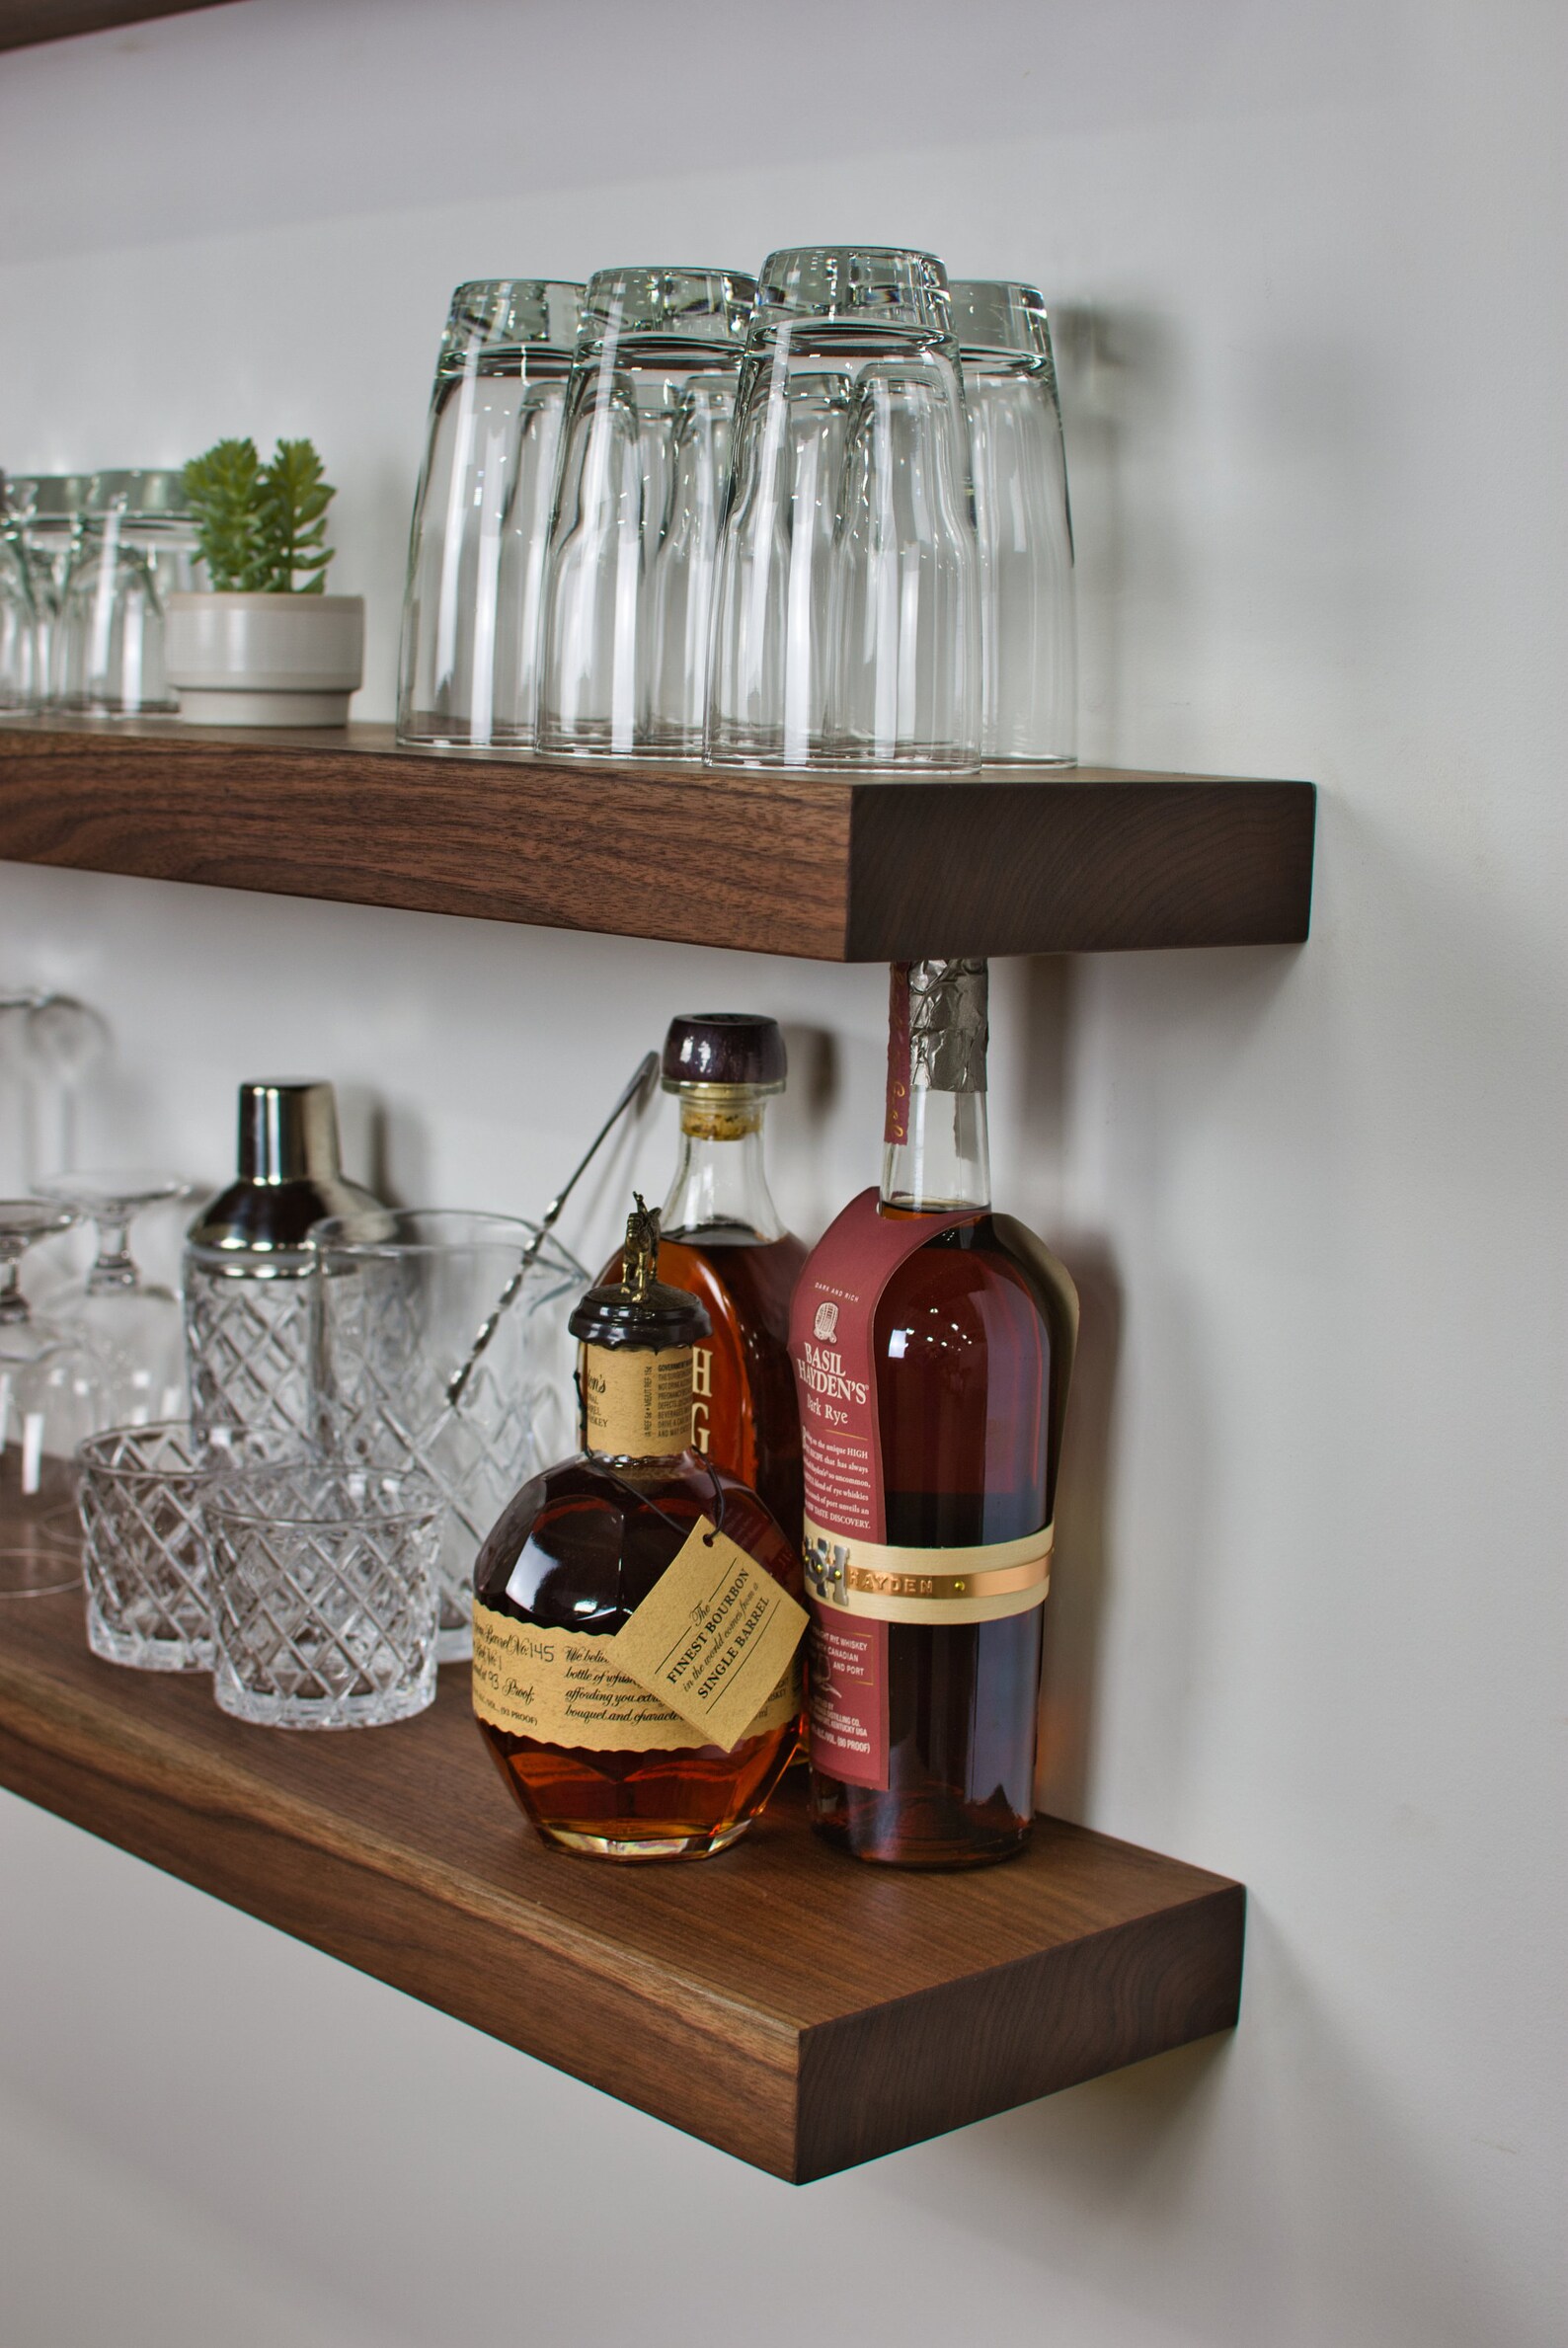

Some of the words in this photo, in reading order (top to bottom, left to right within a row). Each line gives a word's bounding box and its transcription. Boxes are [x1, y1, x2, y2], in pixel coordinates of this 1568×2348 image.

[814, 1282, 830, 1292] DARK
[830, 1288, 844, 1297] AND
[844, 1291, 860, 1302] RICH
[804, 1342, 846, 1376] BASIL
[824, 1403, 848, 1426] Rye
[825, 1444, 846, 1455] unique
[847, 1448, 868, 1459] HIGH
[824, 1455, 835, 1466] that
[837, 1458, 847, 1469] has
[848, 1461, 869, 1474] always
[835, 1473, 871, 1488] uncommon,
[833, 1487, 842, 1497] rye
[843, 1488, 869, 1501] whiskies
[826, 1499, 838, 1509] port
[838, 1501, 860, 1514] unveils
[861, 1507, 869, 1516] an
[829, 1512, 871, 1529] DISCOVERY.
[848, 1569, 933, 1594] HAYDEN
[689, 1600, 711, 1627] The
[666, 1632, 708, 1684] FINEST
[704, 1567, 749, 1634] BOURBON
[529, 1642, 555, 1663] 145
[683, 1679, 694, 1692] in
[692, 1665, 705, 1680] the
[704, 1632, 725, 1666] world
[724, 1609, 743, 1638] comes
[697, 1646, 740, 1699] SINGLE
[735, 1597, 770, 1649] BARREL
[827, 1646, 859, 1662] CANADIAN
[839, 1638, 868, 1652] WHISKEY
[564, 1666, 592, 1680] bottle
[592, 1671, 607, 1684] of
[832, 1661, 845, 1672] AND
[846, 1665, 865, 1676] PORT
[564, 1686, 613, 1707] affording
[611, 1693, 635, 1707] you
[510, 1710, 538, 1726] PROOF)
[564, 1704, 608, 1724] bouquet
[607, 1708, 634, 1722] and
[855, 1727, 868, 1737] USA
[846, 1739, 871, 1755] PROOF)
